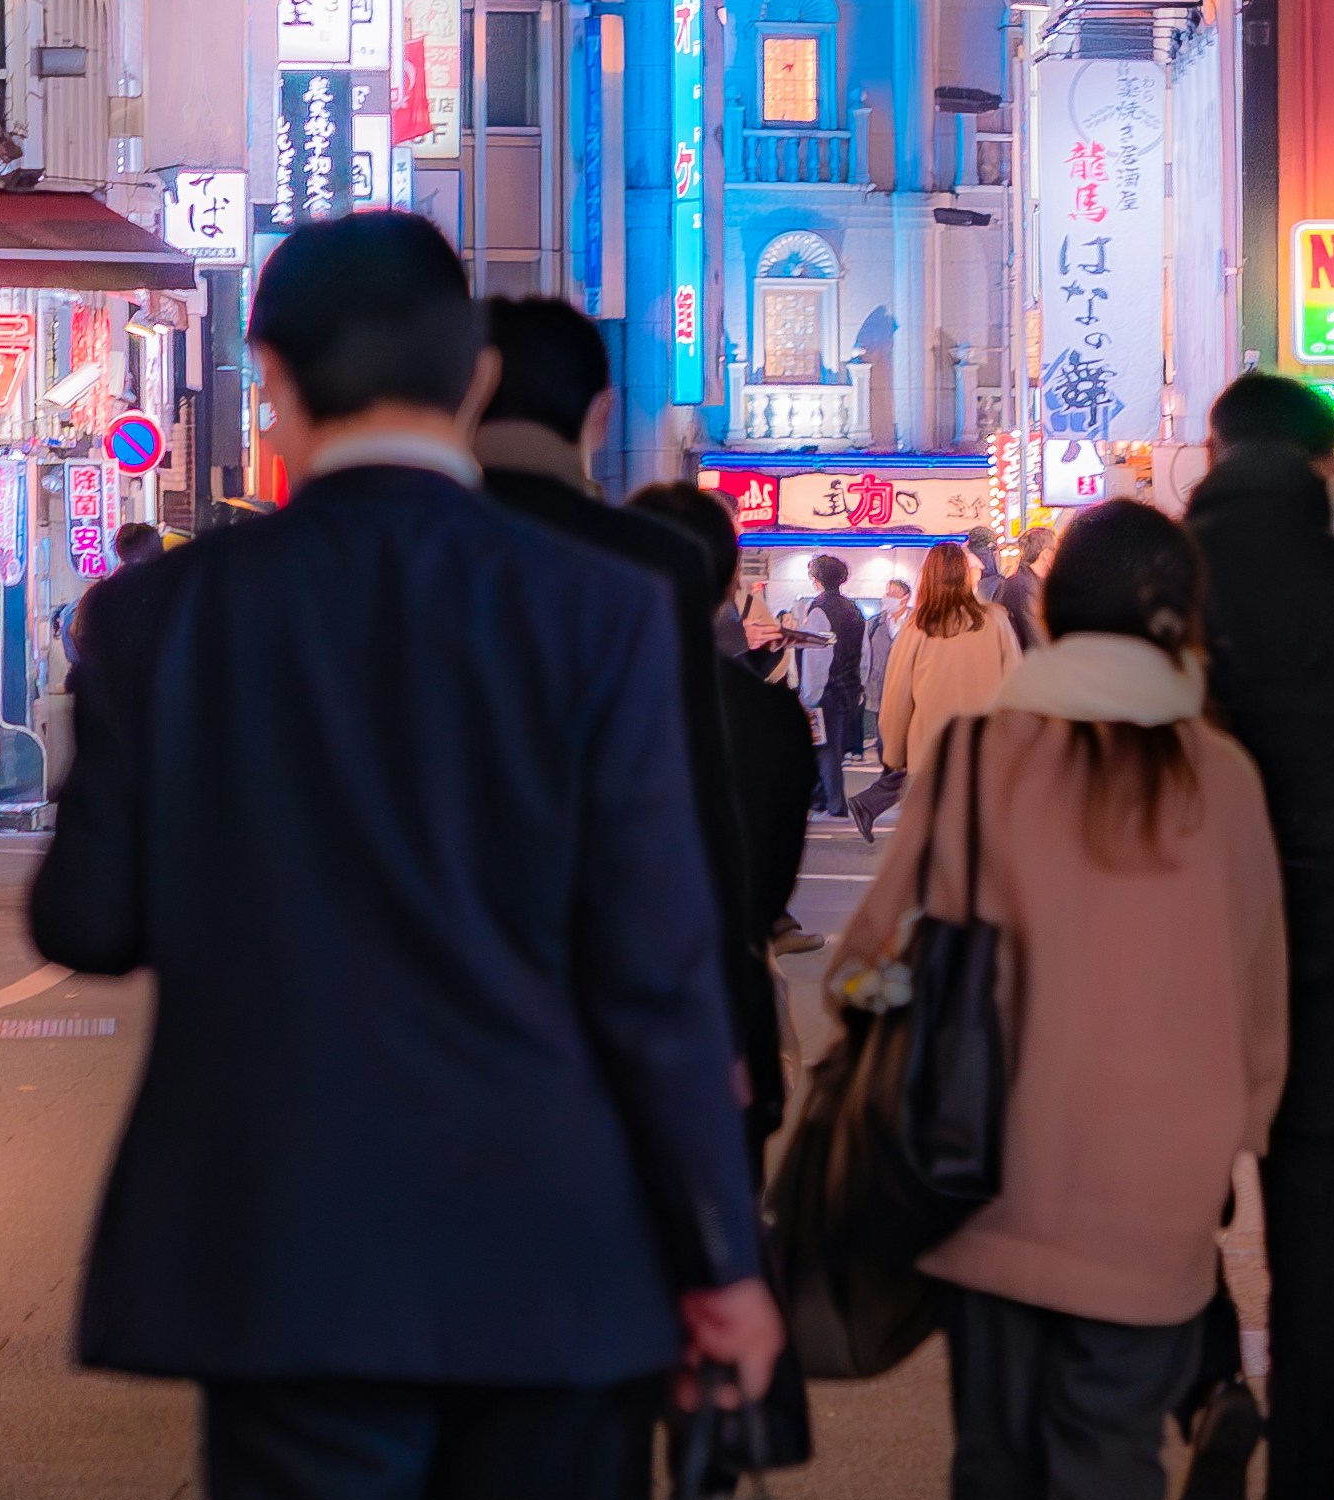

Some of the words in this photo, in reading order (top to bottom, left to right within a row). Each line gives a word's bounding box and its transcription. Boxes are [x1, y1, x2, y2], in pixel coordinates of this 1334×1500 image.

[1063, 140, 1110, 223] 龍馬
[1057, 232, 1113, 428] はなの舞
[69, 467, 108, 577] 除菌安心
